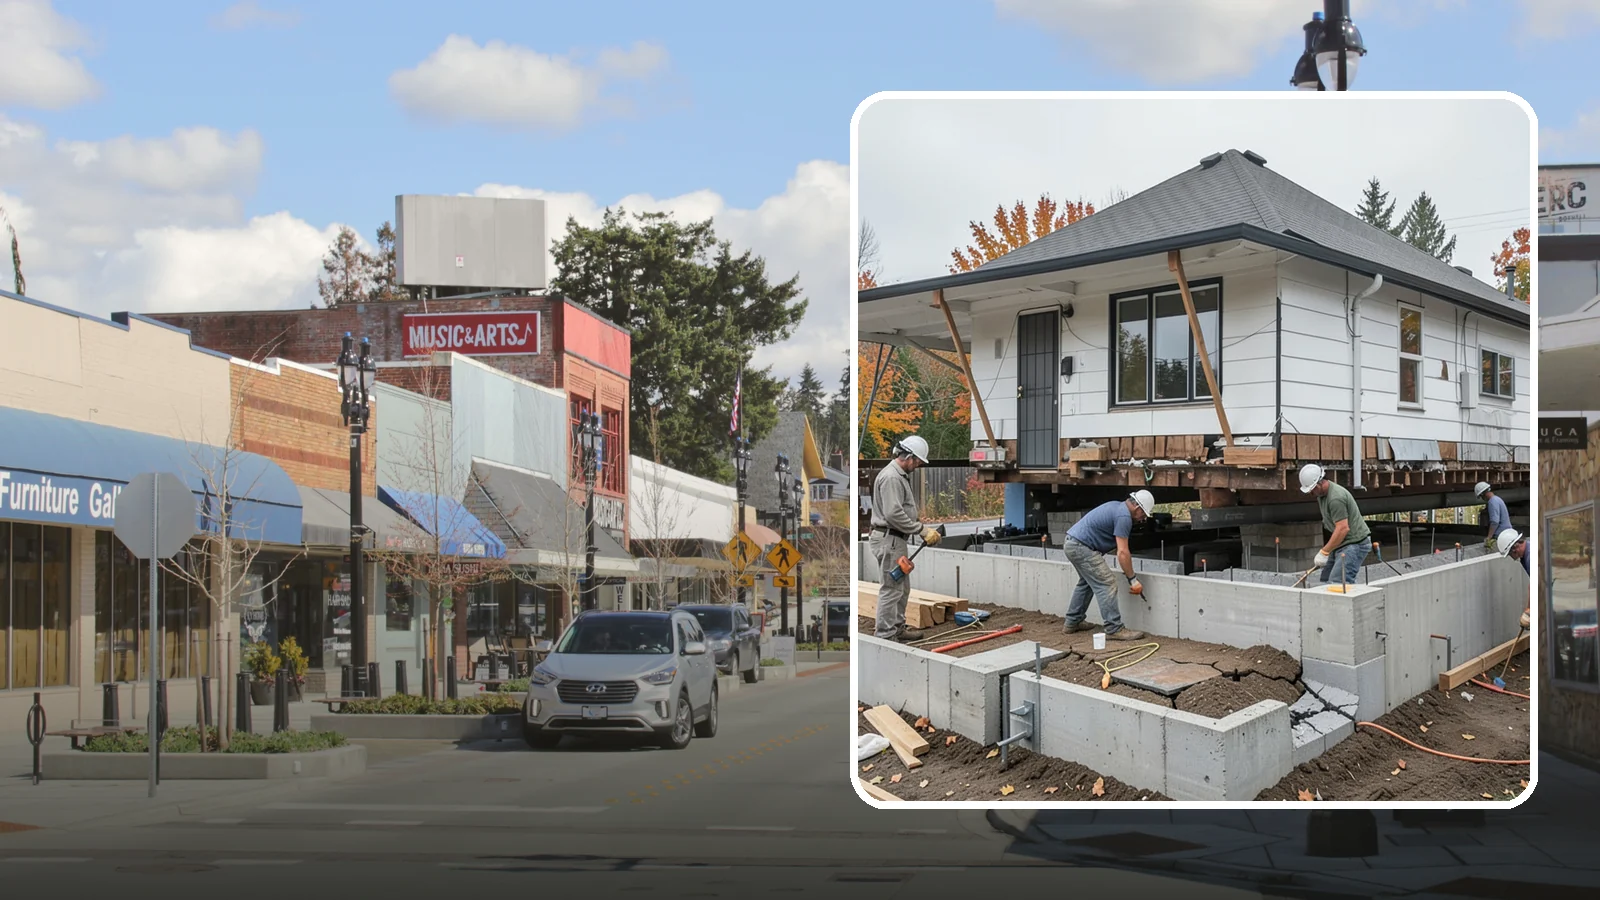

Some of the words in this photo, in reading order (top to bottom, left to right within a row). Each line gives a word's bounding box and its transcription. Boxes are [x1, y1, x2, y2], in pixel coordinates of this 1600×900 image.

[409, 323, 519, 348] MUSIC&ARTS
[0, 472, 79, 515] Furniture
[90, 483, 121, 519] Gal
[453, 563, 479, 574] SUSHI
